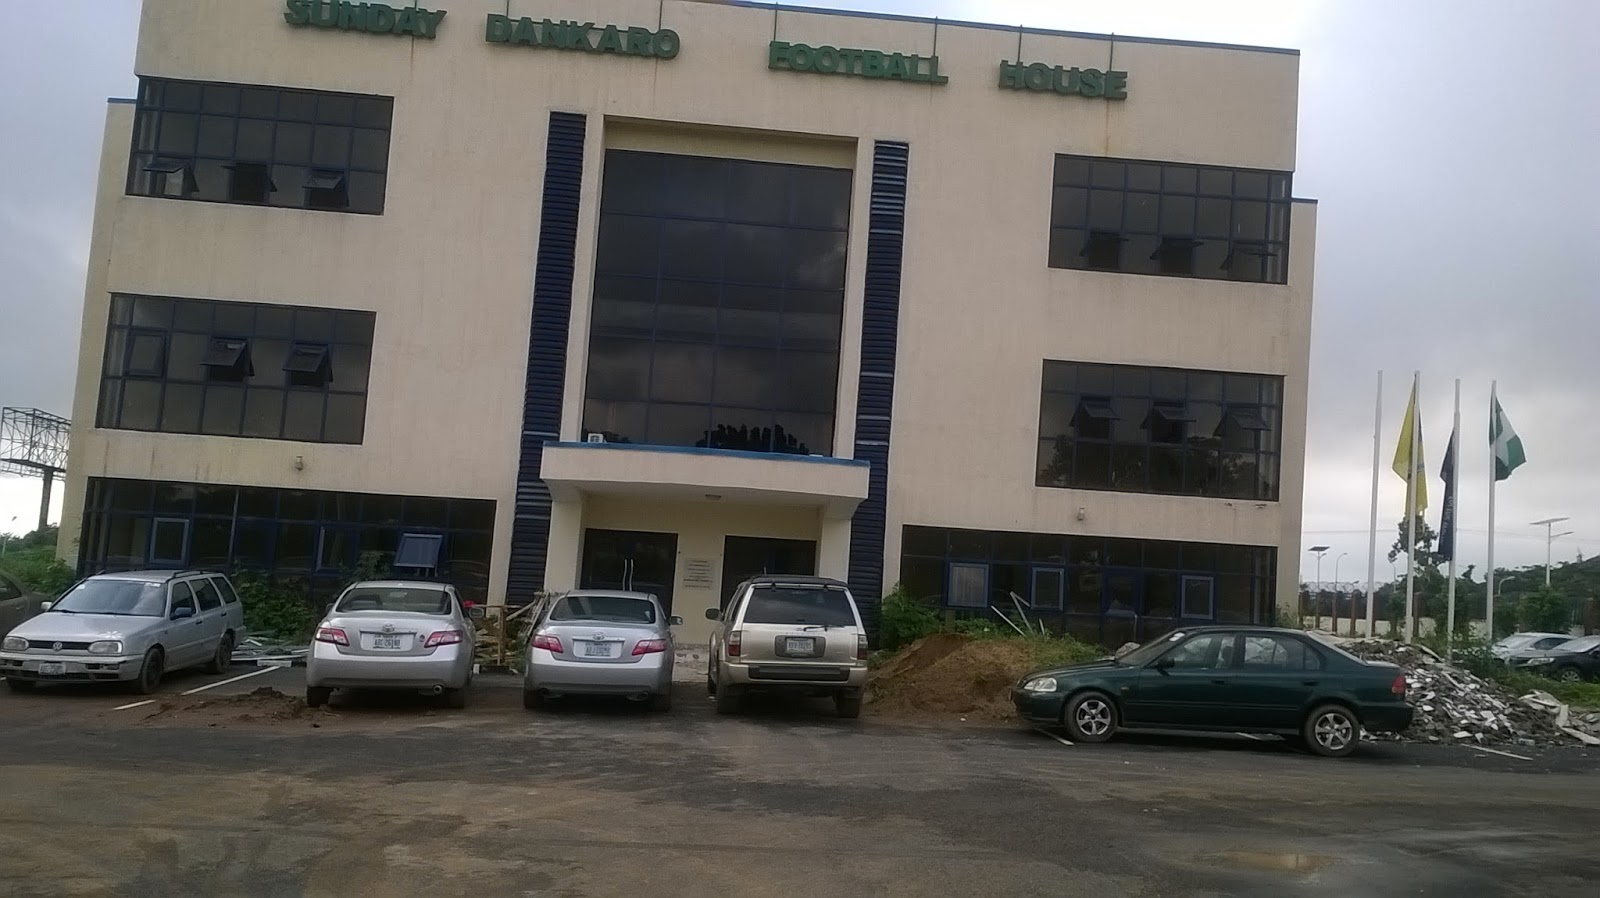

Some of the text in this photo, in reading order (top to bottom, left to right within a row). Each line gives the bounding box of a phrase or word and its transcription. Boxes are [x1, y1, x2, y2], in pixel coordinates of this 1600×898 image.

[284, 0, 1128, 100] SUNDAY DANKARO FOOTBALL HOUSE
